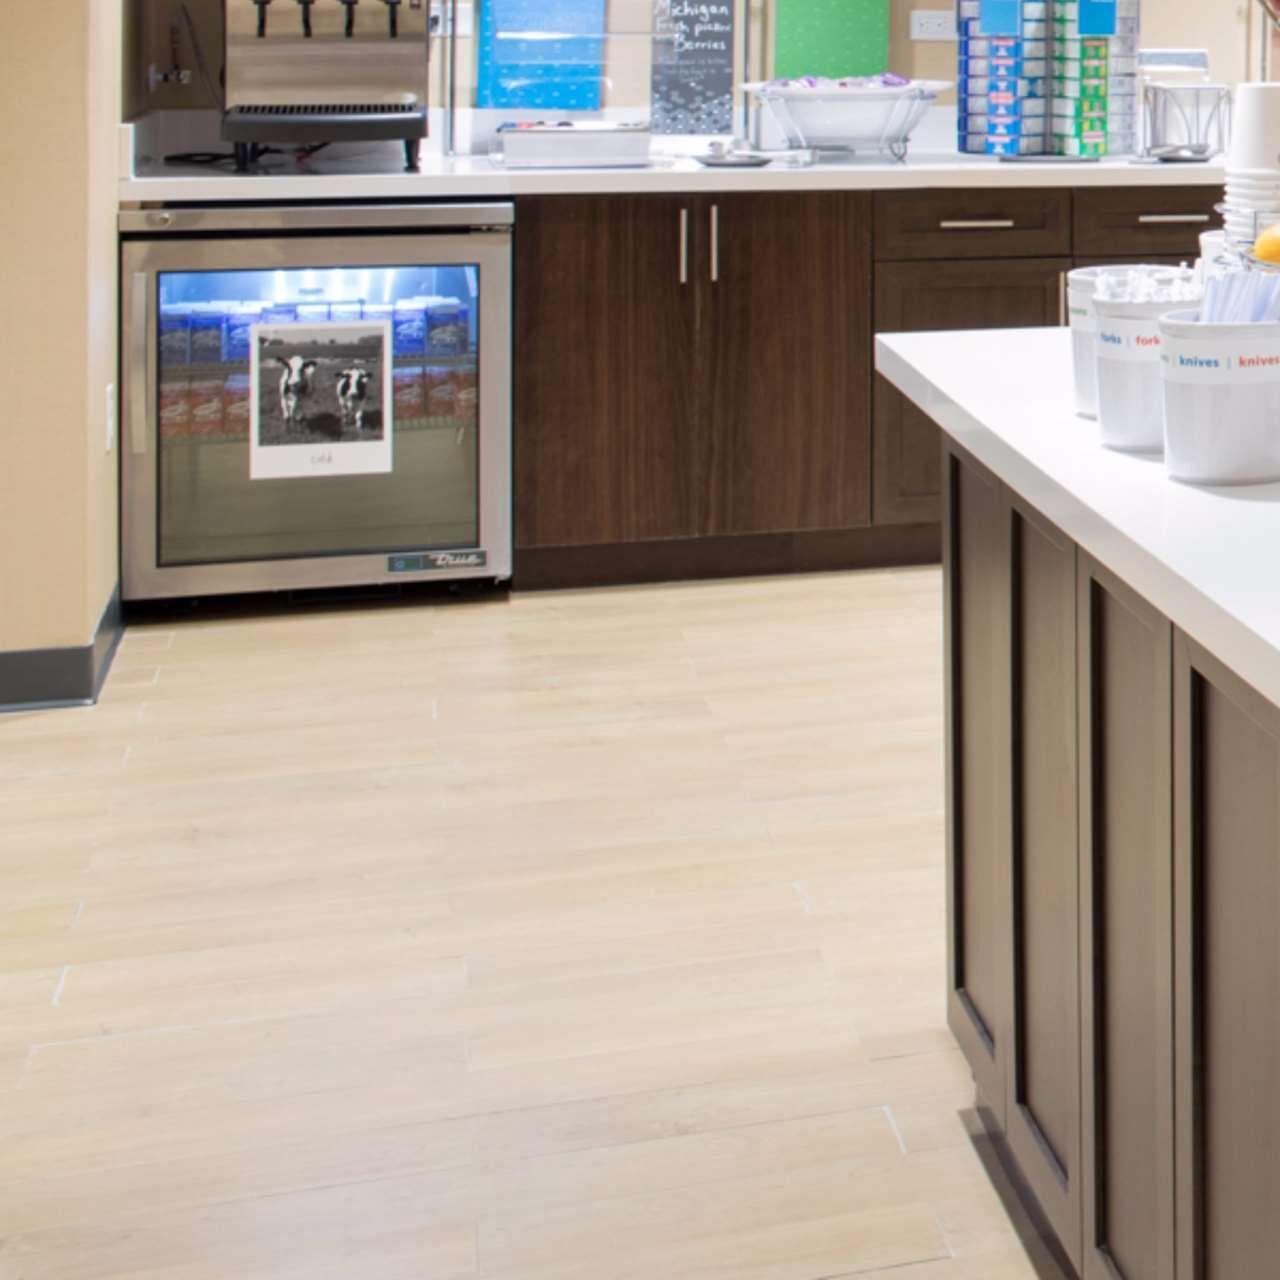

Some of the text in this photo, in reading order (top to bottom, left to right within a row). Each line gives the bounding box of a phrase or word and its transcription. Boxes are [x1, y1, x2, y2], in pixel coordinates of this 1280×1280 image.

[674, 33, 727, 52] Berries
[1135, 335, 1161, 346] fork
[1178, 354, 1220, 368] knives
[1238, 355, 1280, 368] knives
